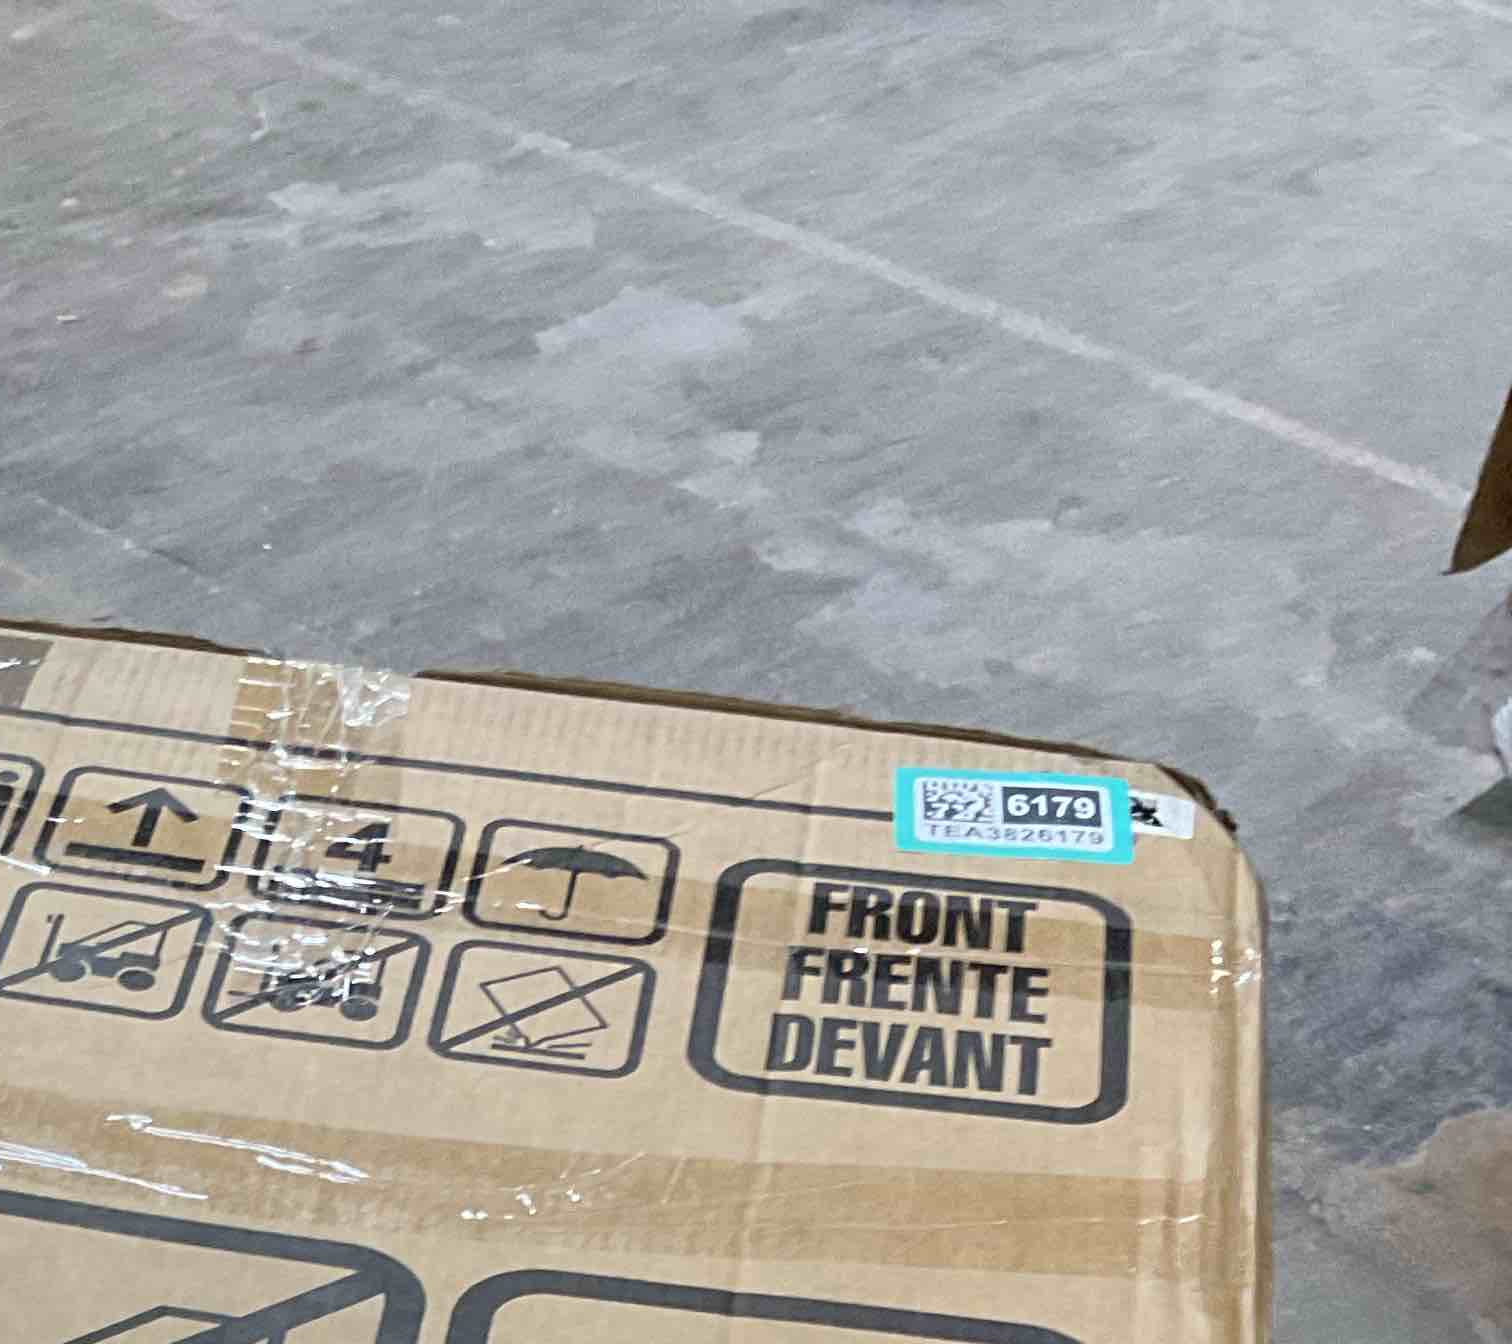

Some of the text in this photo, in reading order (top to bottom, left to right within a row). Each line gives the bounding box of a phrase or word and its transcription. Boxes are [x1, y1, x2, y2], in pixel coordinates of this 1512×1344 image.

[928, 823, 1105, 845] TEA3826179
[1006, 793, 1096, 820] 6179
[325, 821, 393, 873] 4
[807, 881, 1037, 954] FRONT
[780, 945, 1049, 1025] FRENTE
[763, 1012, 1053, 1097] DEVANT
